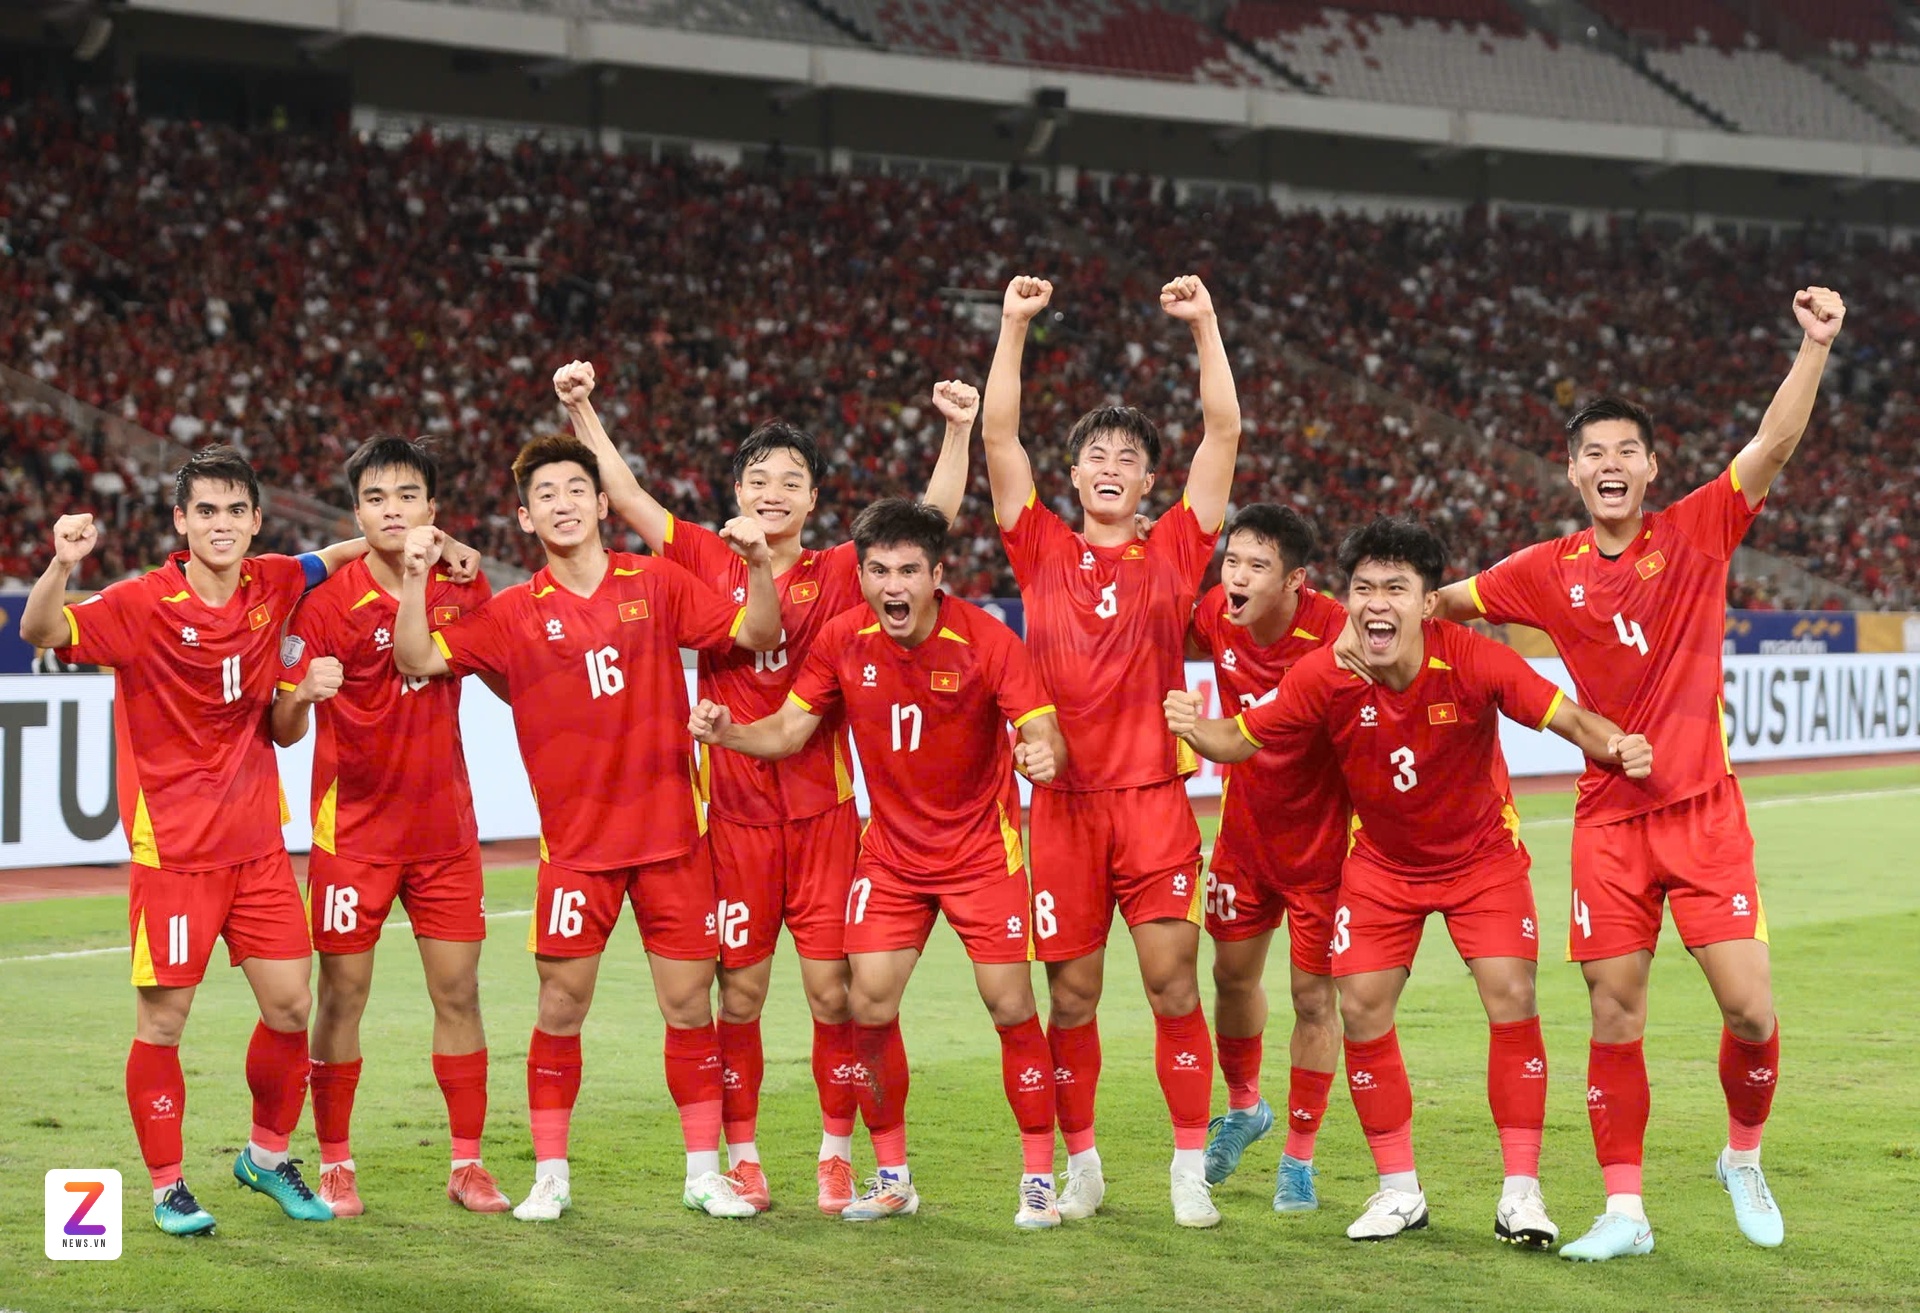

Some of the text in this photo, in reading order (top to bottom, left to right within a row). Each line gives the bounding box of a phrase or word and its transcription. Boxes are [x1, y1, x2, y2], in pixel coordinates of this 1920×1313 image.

[1612, 611, 1650, 657] 4
[222, 654, 243, 705] 11
[584, 645, 625, 700] 16
[891, 702, 923, 753] 17
[1723, 666, 1920, 747] SUSTAINAB
[1389, 745, 1418, 793] 3
[323, 884, 359, 935] 18
[548, 886, 587, 939] 16
[717, 899, 750, 950] 12
[845, 877, 872, 926] 17
[1034, 889, 1058, 940] 8
[1573, 888, 1593, 940] 4
[168, 914, 189, 966] 11
